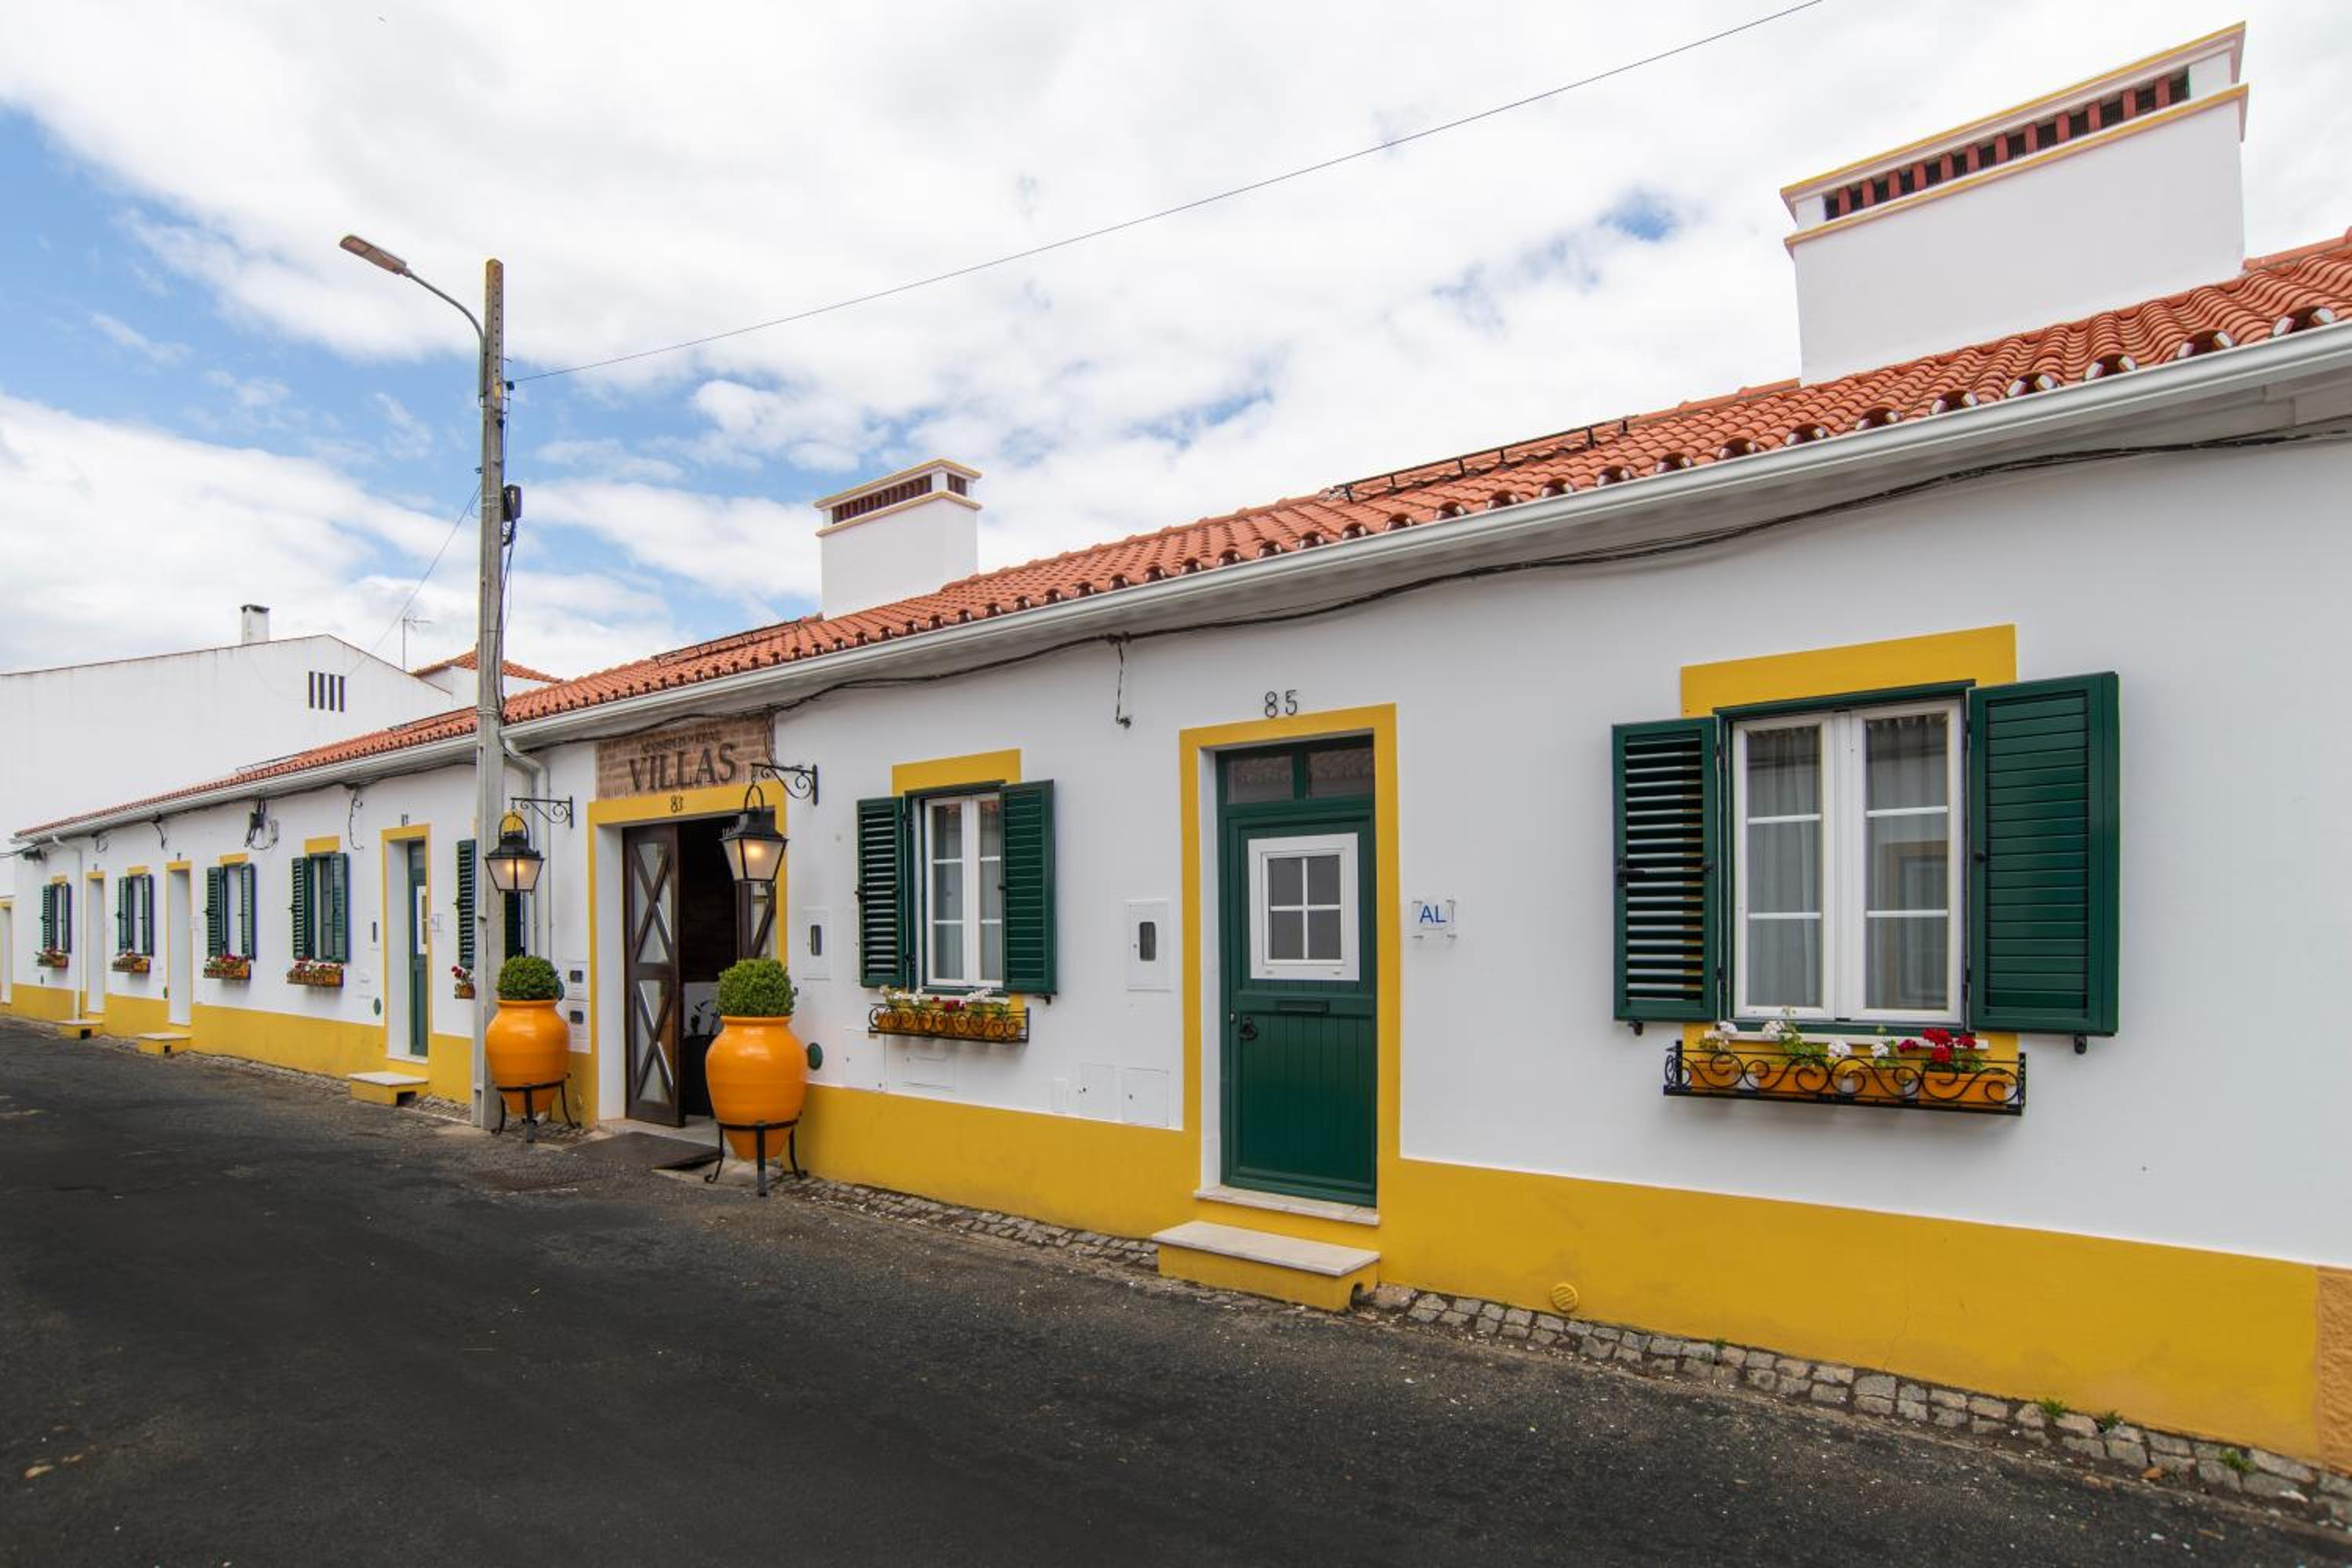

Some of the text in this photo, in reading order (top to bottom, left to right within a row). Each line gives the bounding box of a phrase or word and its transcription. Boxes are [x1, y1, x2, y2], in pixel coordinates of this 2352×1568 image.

[1265, 690, 1298, 719] 85
[629, 742, 737, 791] VILLAS
[670, 795, 684, 813] 83
[1420, 904, 1447, 924] AL
